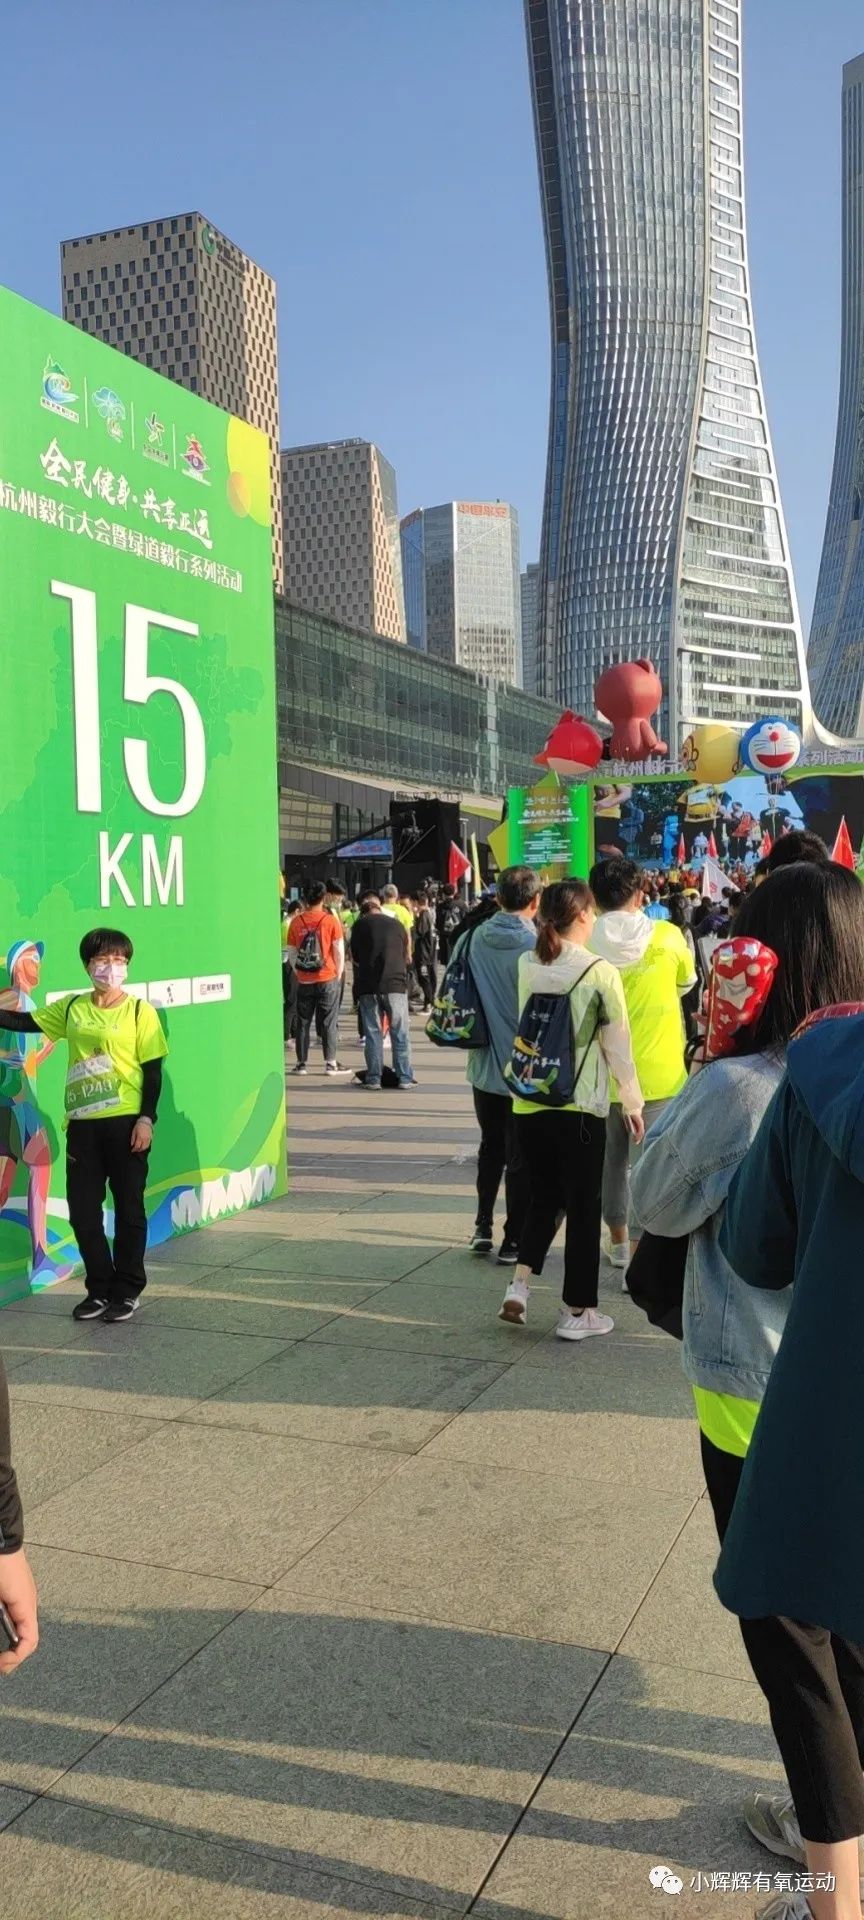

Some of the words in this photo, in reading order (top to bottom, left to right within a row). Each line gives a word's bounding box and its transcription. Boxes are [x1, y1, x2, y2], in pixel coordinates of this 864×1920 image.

[0, 478, 243, 593] 杭州毅行大会暨绿道毅行系列活动
[50, 579, 207, 817] 15
[99, 831, 184, 908] KM
